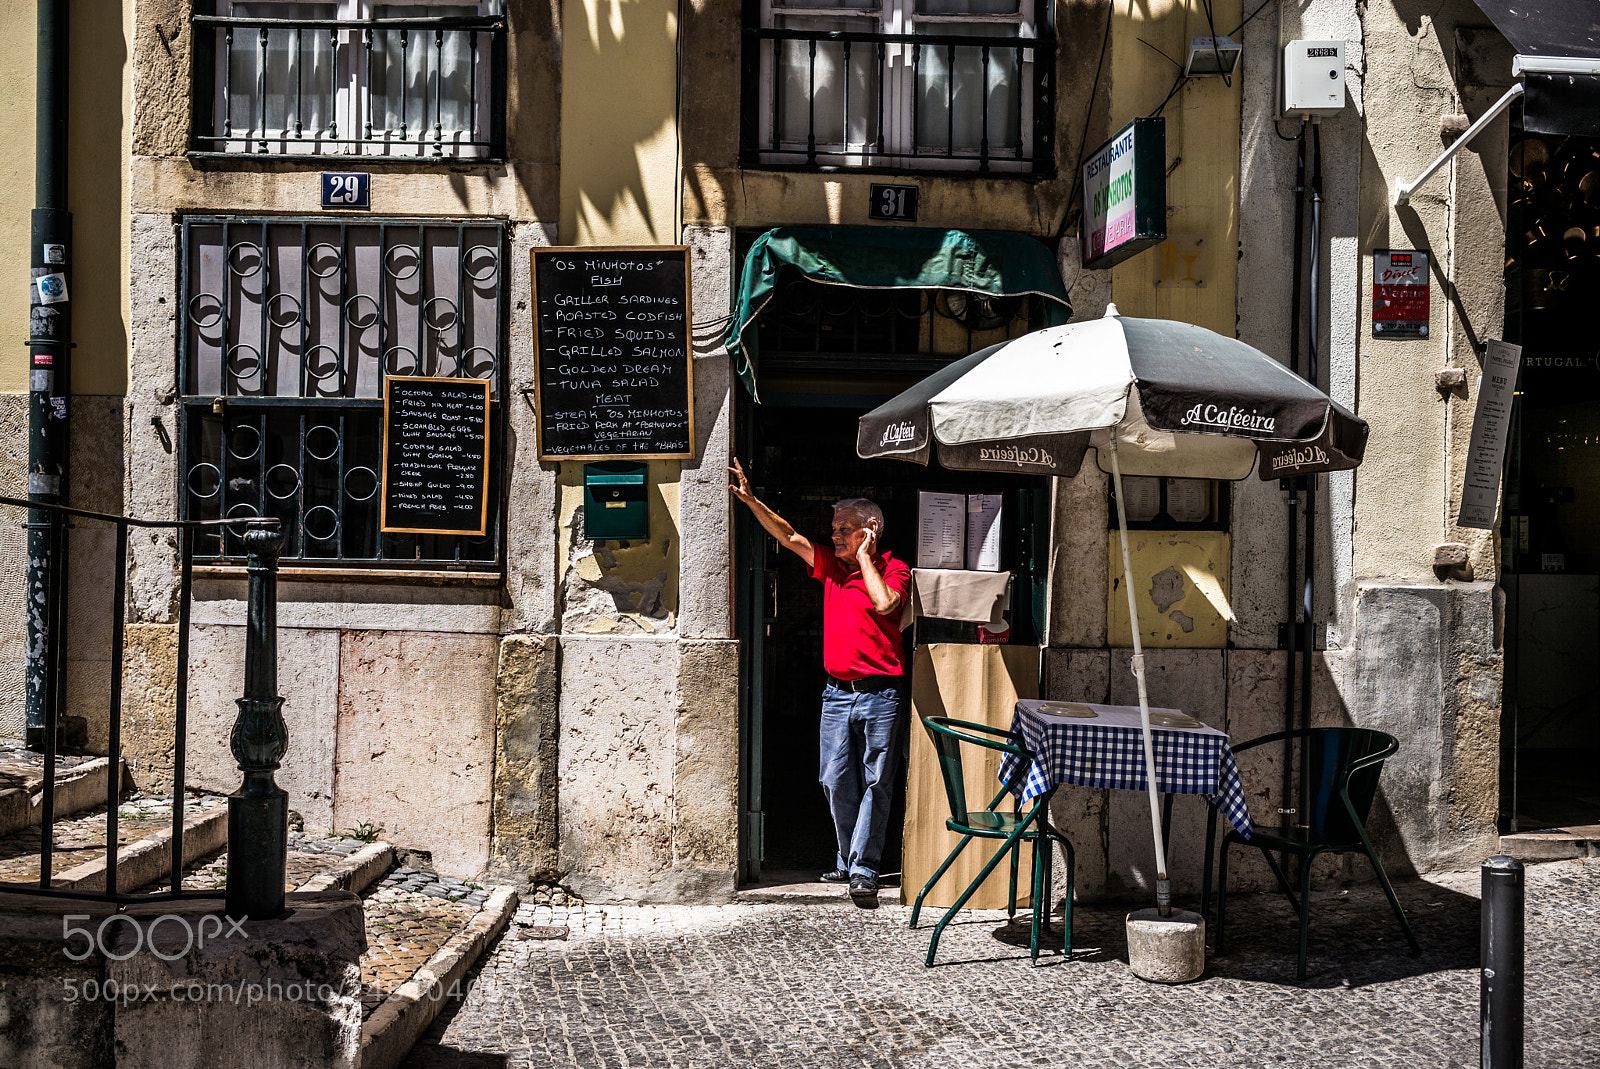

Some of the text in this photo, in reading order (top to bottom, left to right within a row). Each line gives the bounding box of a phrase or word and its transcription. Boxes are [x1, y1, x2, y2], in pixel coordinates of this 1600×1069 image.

[1087, 132, 1133, 180] RESTAURANTE
[330, 175, 359, 203] 29
[881, 188, 906, 217] 31
[1382, 265, 1422, 281] Direct
[591, 276, 623, 286] FISH
[554, 294, 679, 306] GRILLER SARDINES
[556, 310, 683, 321] ROASTED CODFISH
[557, 326, 676, 342] FRIED SQUIDS
[558, 345, 684, 359] GRILLED SALMON
[558, 364, 672, 375] GOLDEN DREAM
[559, 377, 660, 390] TUNA SALAD
[441, 391, 467, 399] SALAD
[595, 394, 632, 404] MEAT
[402, 398, 426, 407] FRIED
[401, 409, 437, 420] SAUSAGE
[441, 413, 461, 421] ROAST
[554, 410, 598, 419] STEAK
[1181, 403, 1275, 432] A Caféeira
[402, 422, 472, 433] SCRAMBLED EGGS
[556, 422, 590, 431] FRIED
[595, 420, 619, 429] PORK
[426, 431, 456, 439] SAUSAGE
[593, 430, 652, 440] VEGETARIAN
[551, 443, 610, 454] VEGETABLES
[616, 443, 628, 452] OF
